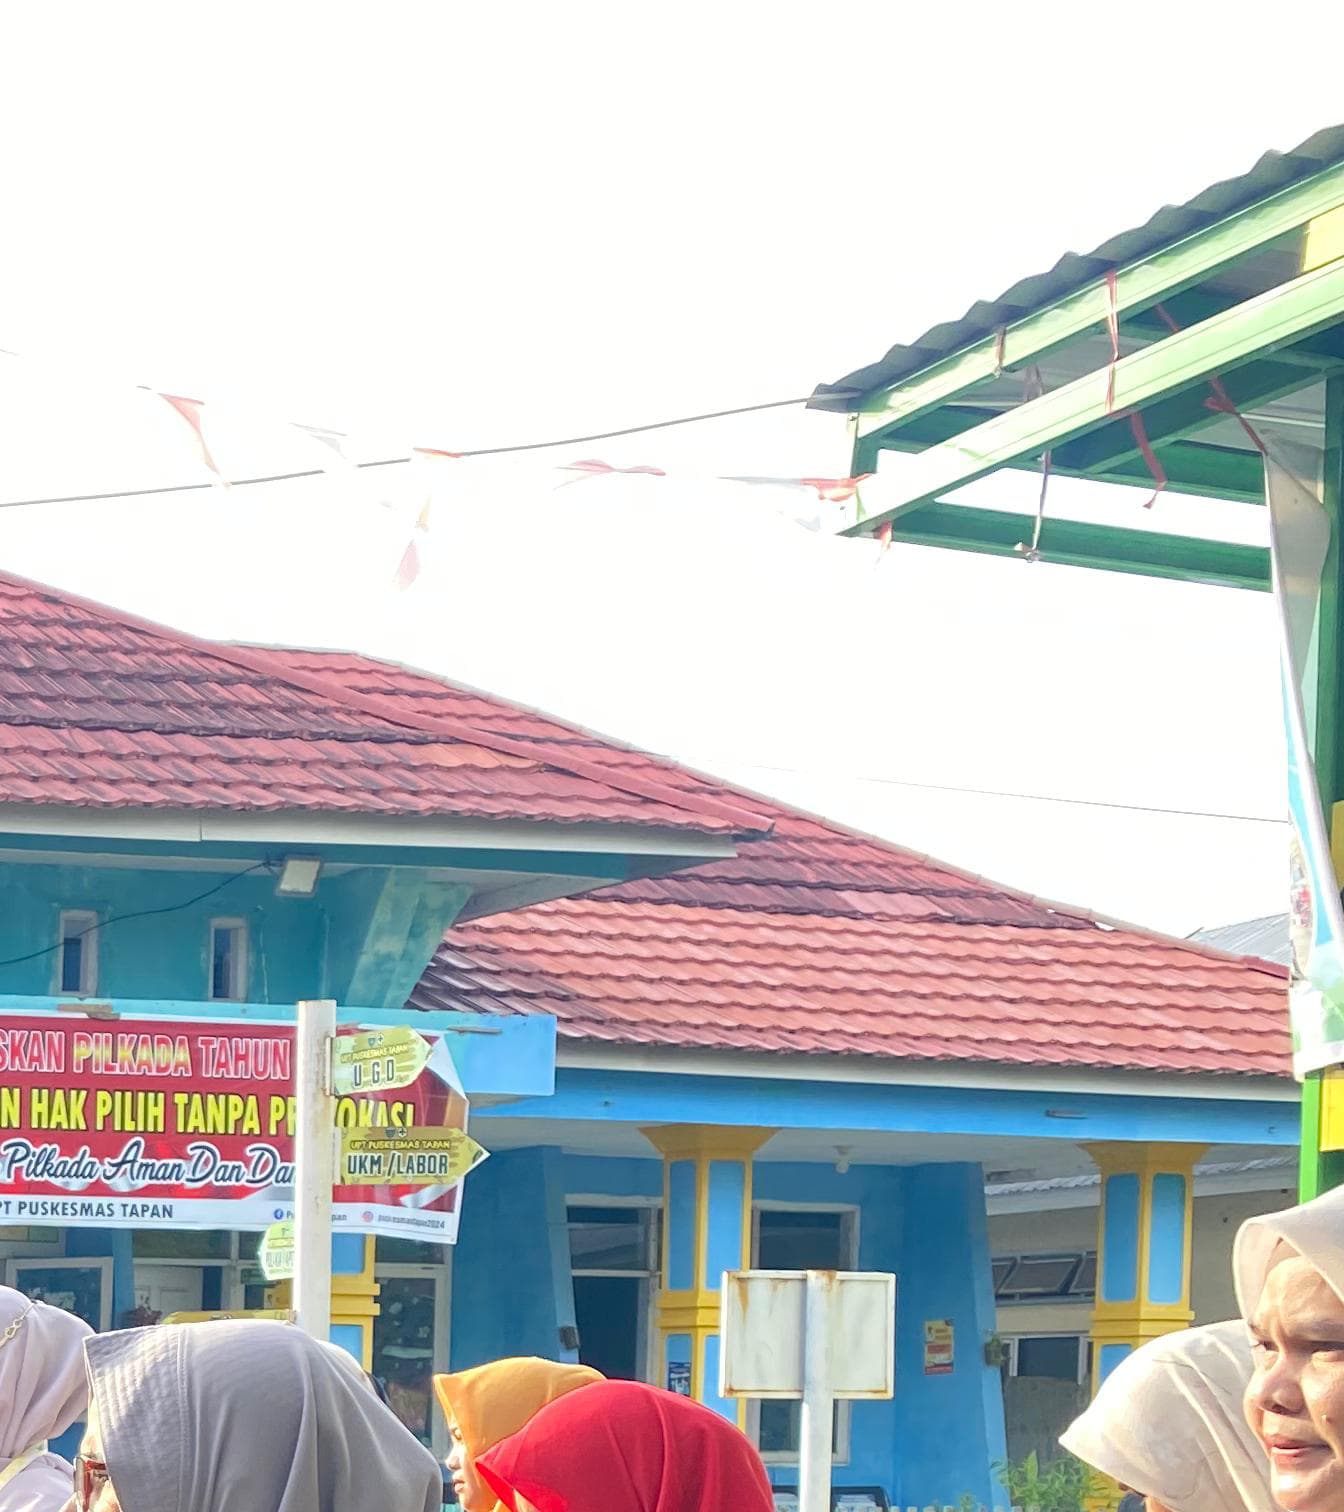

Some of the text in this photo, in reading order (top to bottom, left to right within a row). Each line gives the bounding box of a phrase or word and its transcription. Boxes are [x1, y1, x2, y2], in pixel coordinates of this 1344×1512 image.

[73, 1031, 192, 1077] PILKADA
[198, 1037, 290, 1080] TAHUN
[30, 1088, 88, 1131] HAK
[96, 1090, 165, 1133] PILIH
[174, 1092, 261, 1135] TANPA
[2, 1141, 99, 1179] Pilkada
[102, 1139, 185, 1182] Aman
[185, 1145, 245, 1183] Dan
[368, 1140, 420, 1150] PUSKESMAS
[422, 1141, 450, 1150] TAPAN
[348, 1154, 382, 1175] UKM
[18, 1201, 115, 1217] PUSKESMAS
[122, 1204, 173, 1218] TAPAN
